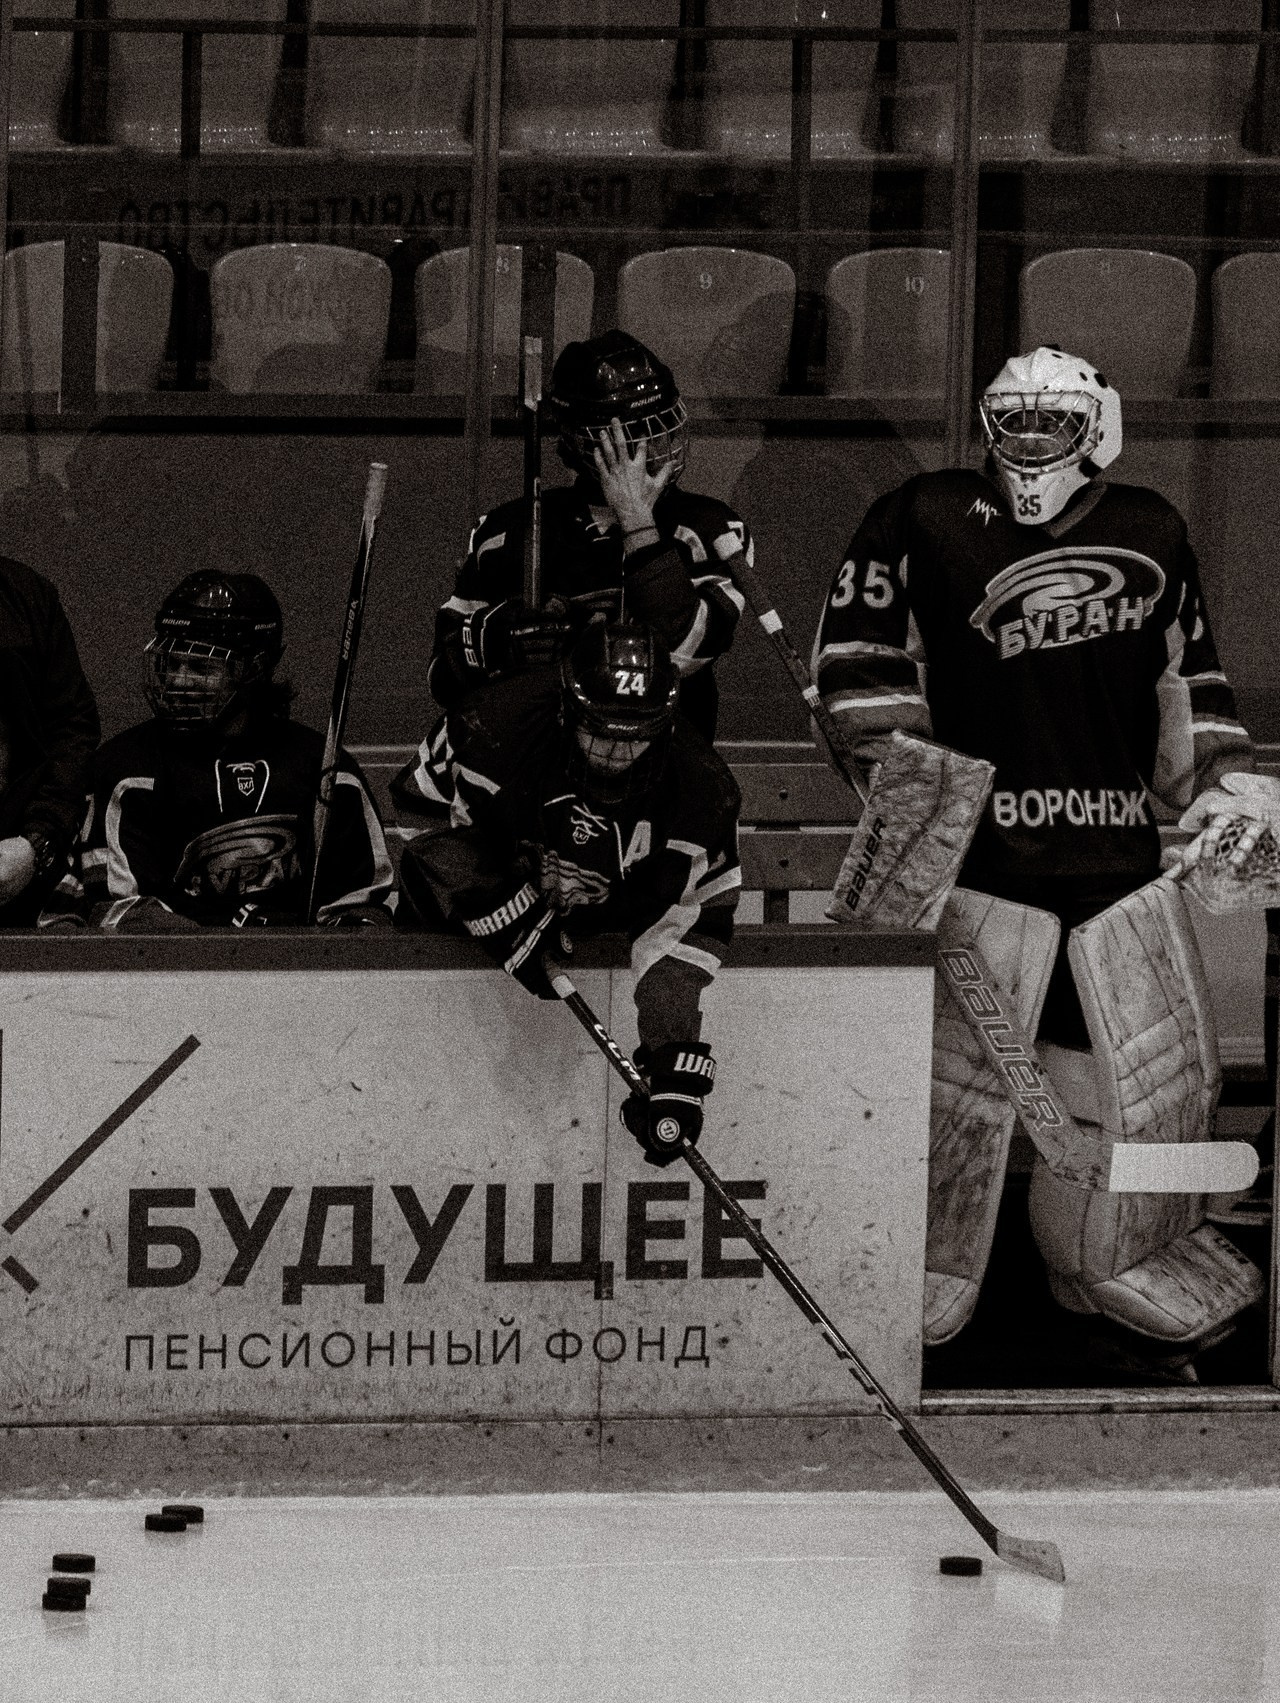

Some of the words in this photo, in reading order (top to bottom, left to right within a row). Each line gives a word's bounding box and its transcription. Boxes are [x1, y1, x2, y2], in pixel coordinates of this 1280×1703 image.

[1017, 494, 1042, 517] 35
[831, 559, 895, 609] 35
[998, 596, 1145, 660] БУРАН
[614, 670, 646, 697] 24
[994, 788, 1147, 827] ВОРОНЕЖ
[845, 816, 887, 911] BAUER
[938, 948, 1063, 1131] BAUER
[127, 1180, 767, 1305] БУДУЩЕЕ
[125, 1317, 521, 1372] ПЕНСИОННЫЙ
[545, 1325, 710, 1369] ФОНД
